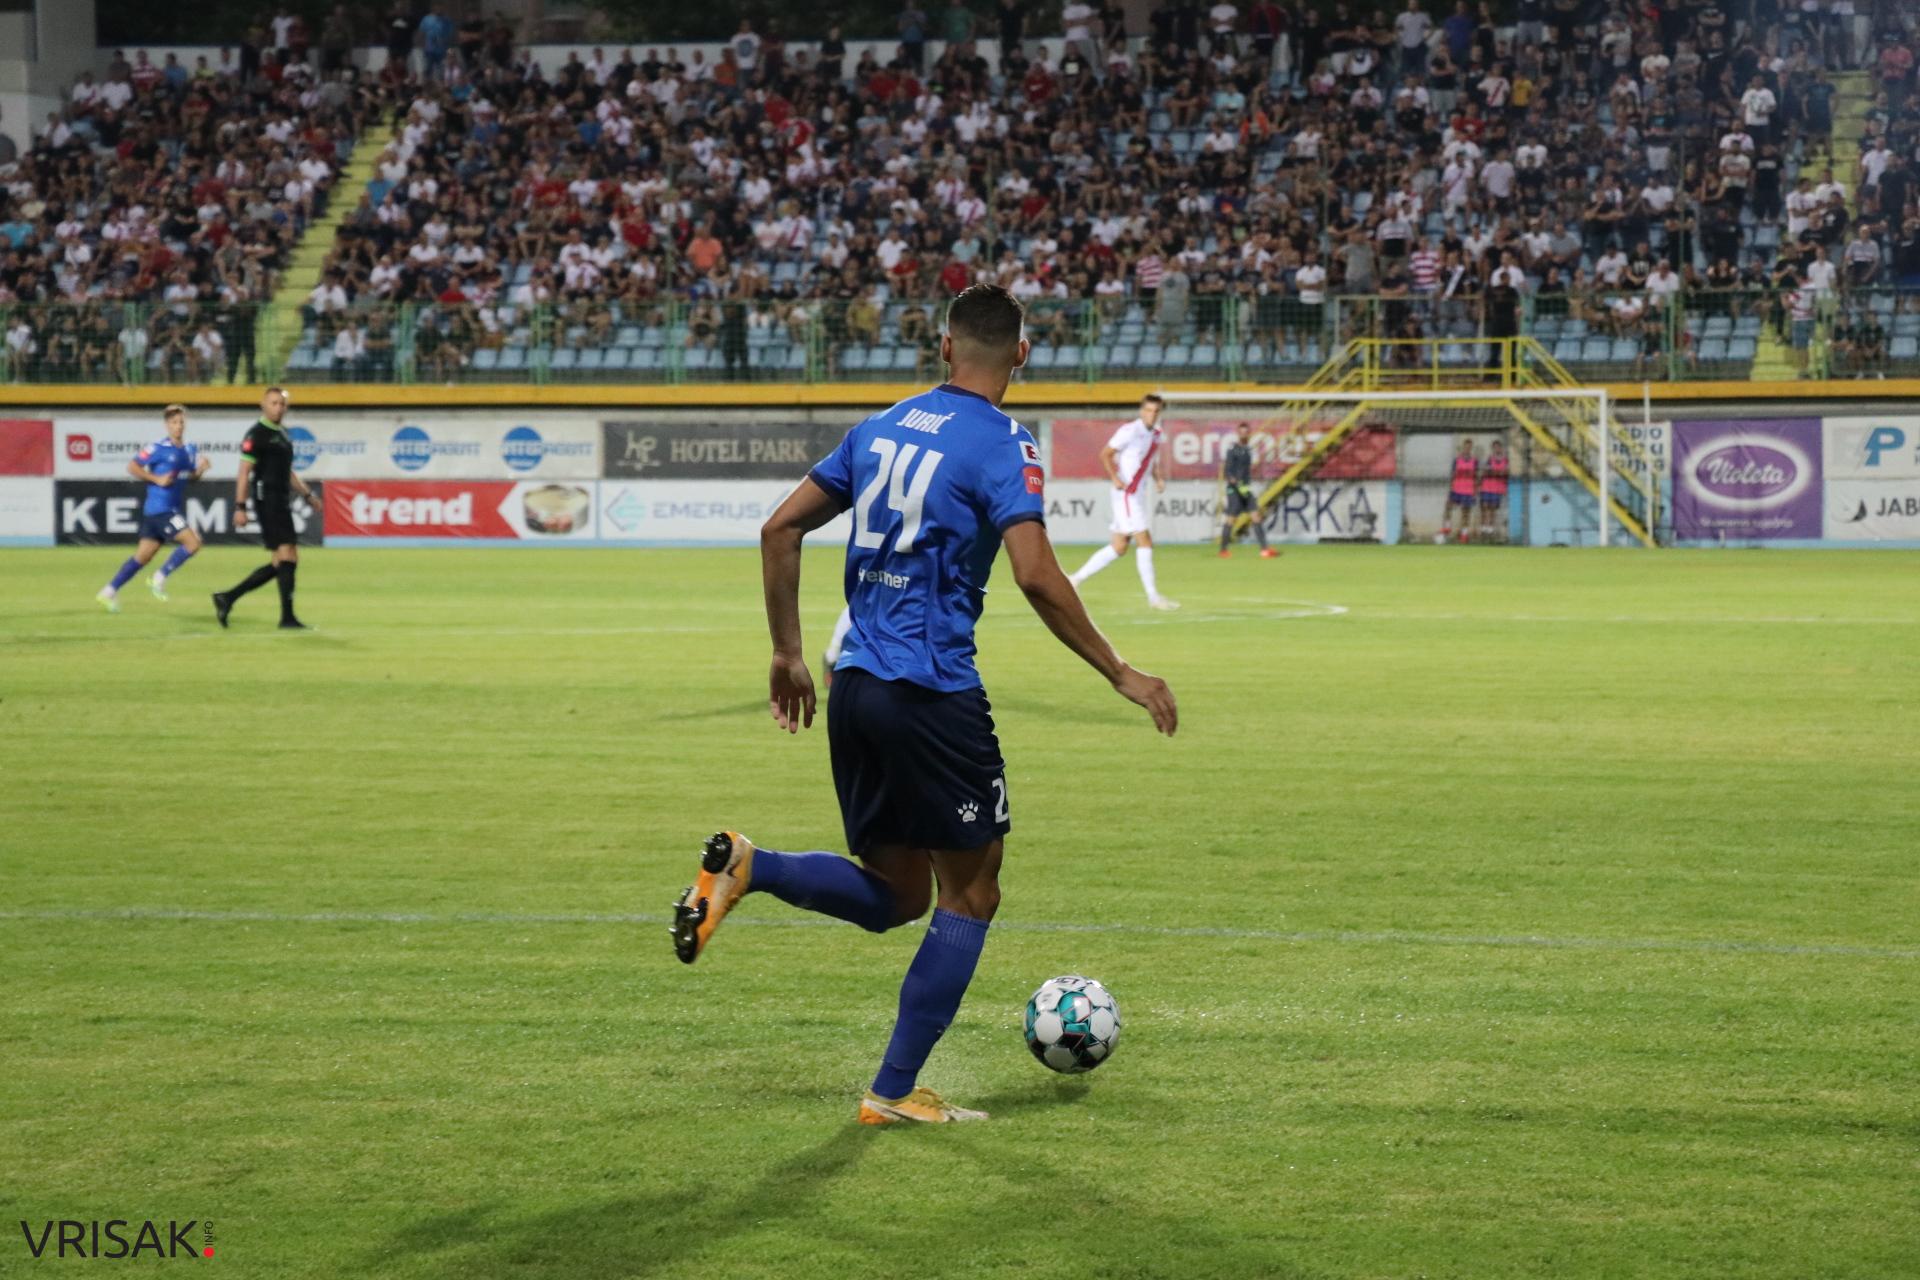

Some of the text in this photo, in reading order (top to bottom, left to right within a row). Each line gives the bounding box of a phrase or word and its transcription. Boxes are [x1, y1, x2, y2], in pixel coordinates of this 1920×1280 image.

[896, 408, 957, 435] JURIĆ
[671, 439, 809, 463] HOTEL PARK
[1706, 457, 1786, 485] Violeta
[351, 491, 473, 526] trend
[855, 437, 945, 553] 24
[1875, 497, 1920, 518] JAB
[62, 497, 263, 534] KEME
[653, 501, 761, 520] EMERUS
[1045, 500, 1096, 518] A.TV
[991, 776, 1010, 824] 2
